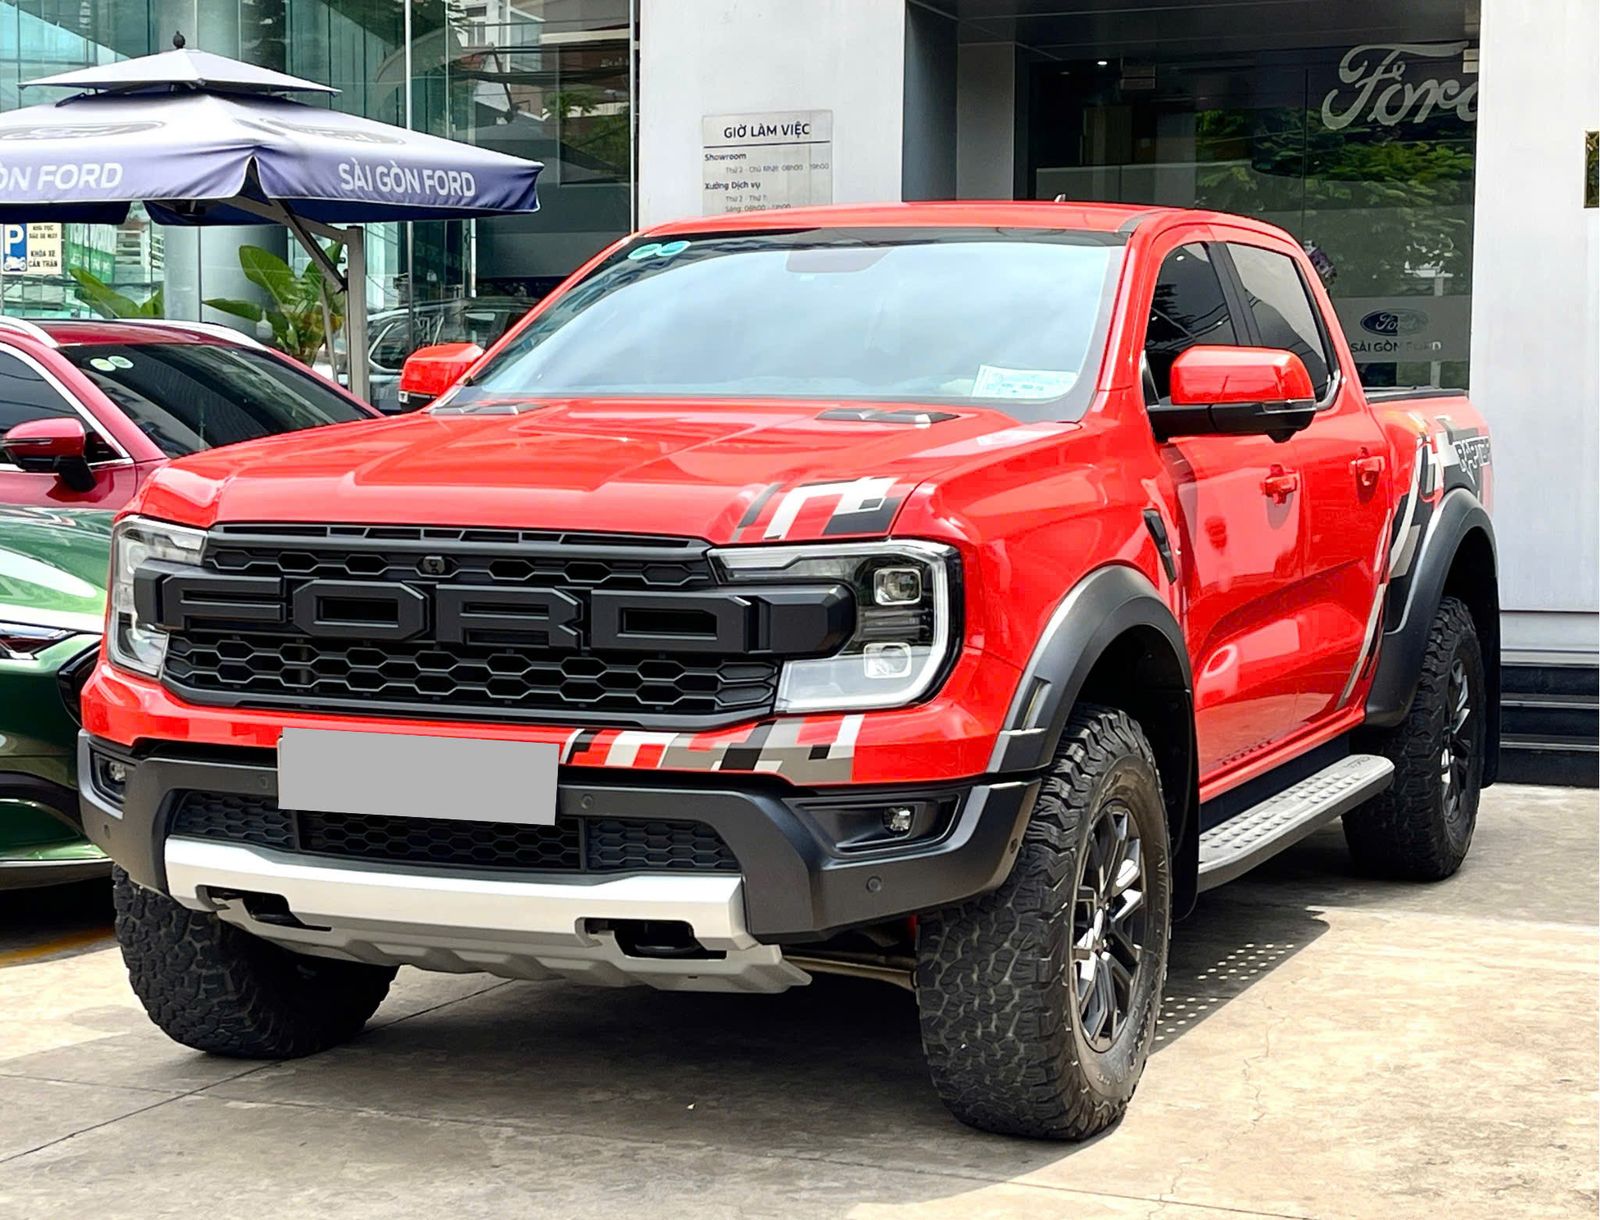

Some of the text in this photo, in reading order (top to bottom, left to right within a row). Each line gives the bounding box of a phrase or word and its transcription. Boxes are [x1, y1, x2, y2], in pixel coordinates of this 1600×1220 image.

[724, 121, 810, 138] GIỜ LÀM VIỆC
[704, 153, 746, 161] Showroom
[37, 163, 123, 190] FORD
[338, 158, 476, 196] SÀI GÒN FORD
[5, 225, 24, 255] P
[1350, 340, 1371, 352] SÀI
[157, 572, 752, 652] FORD
